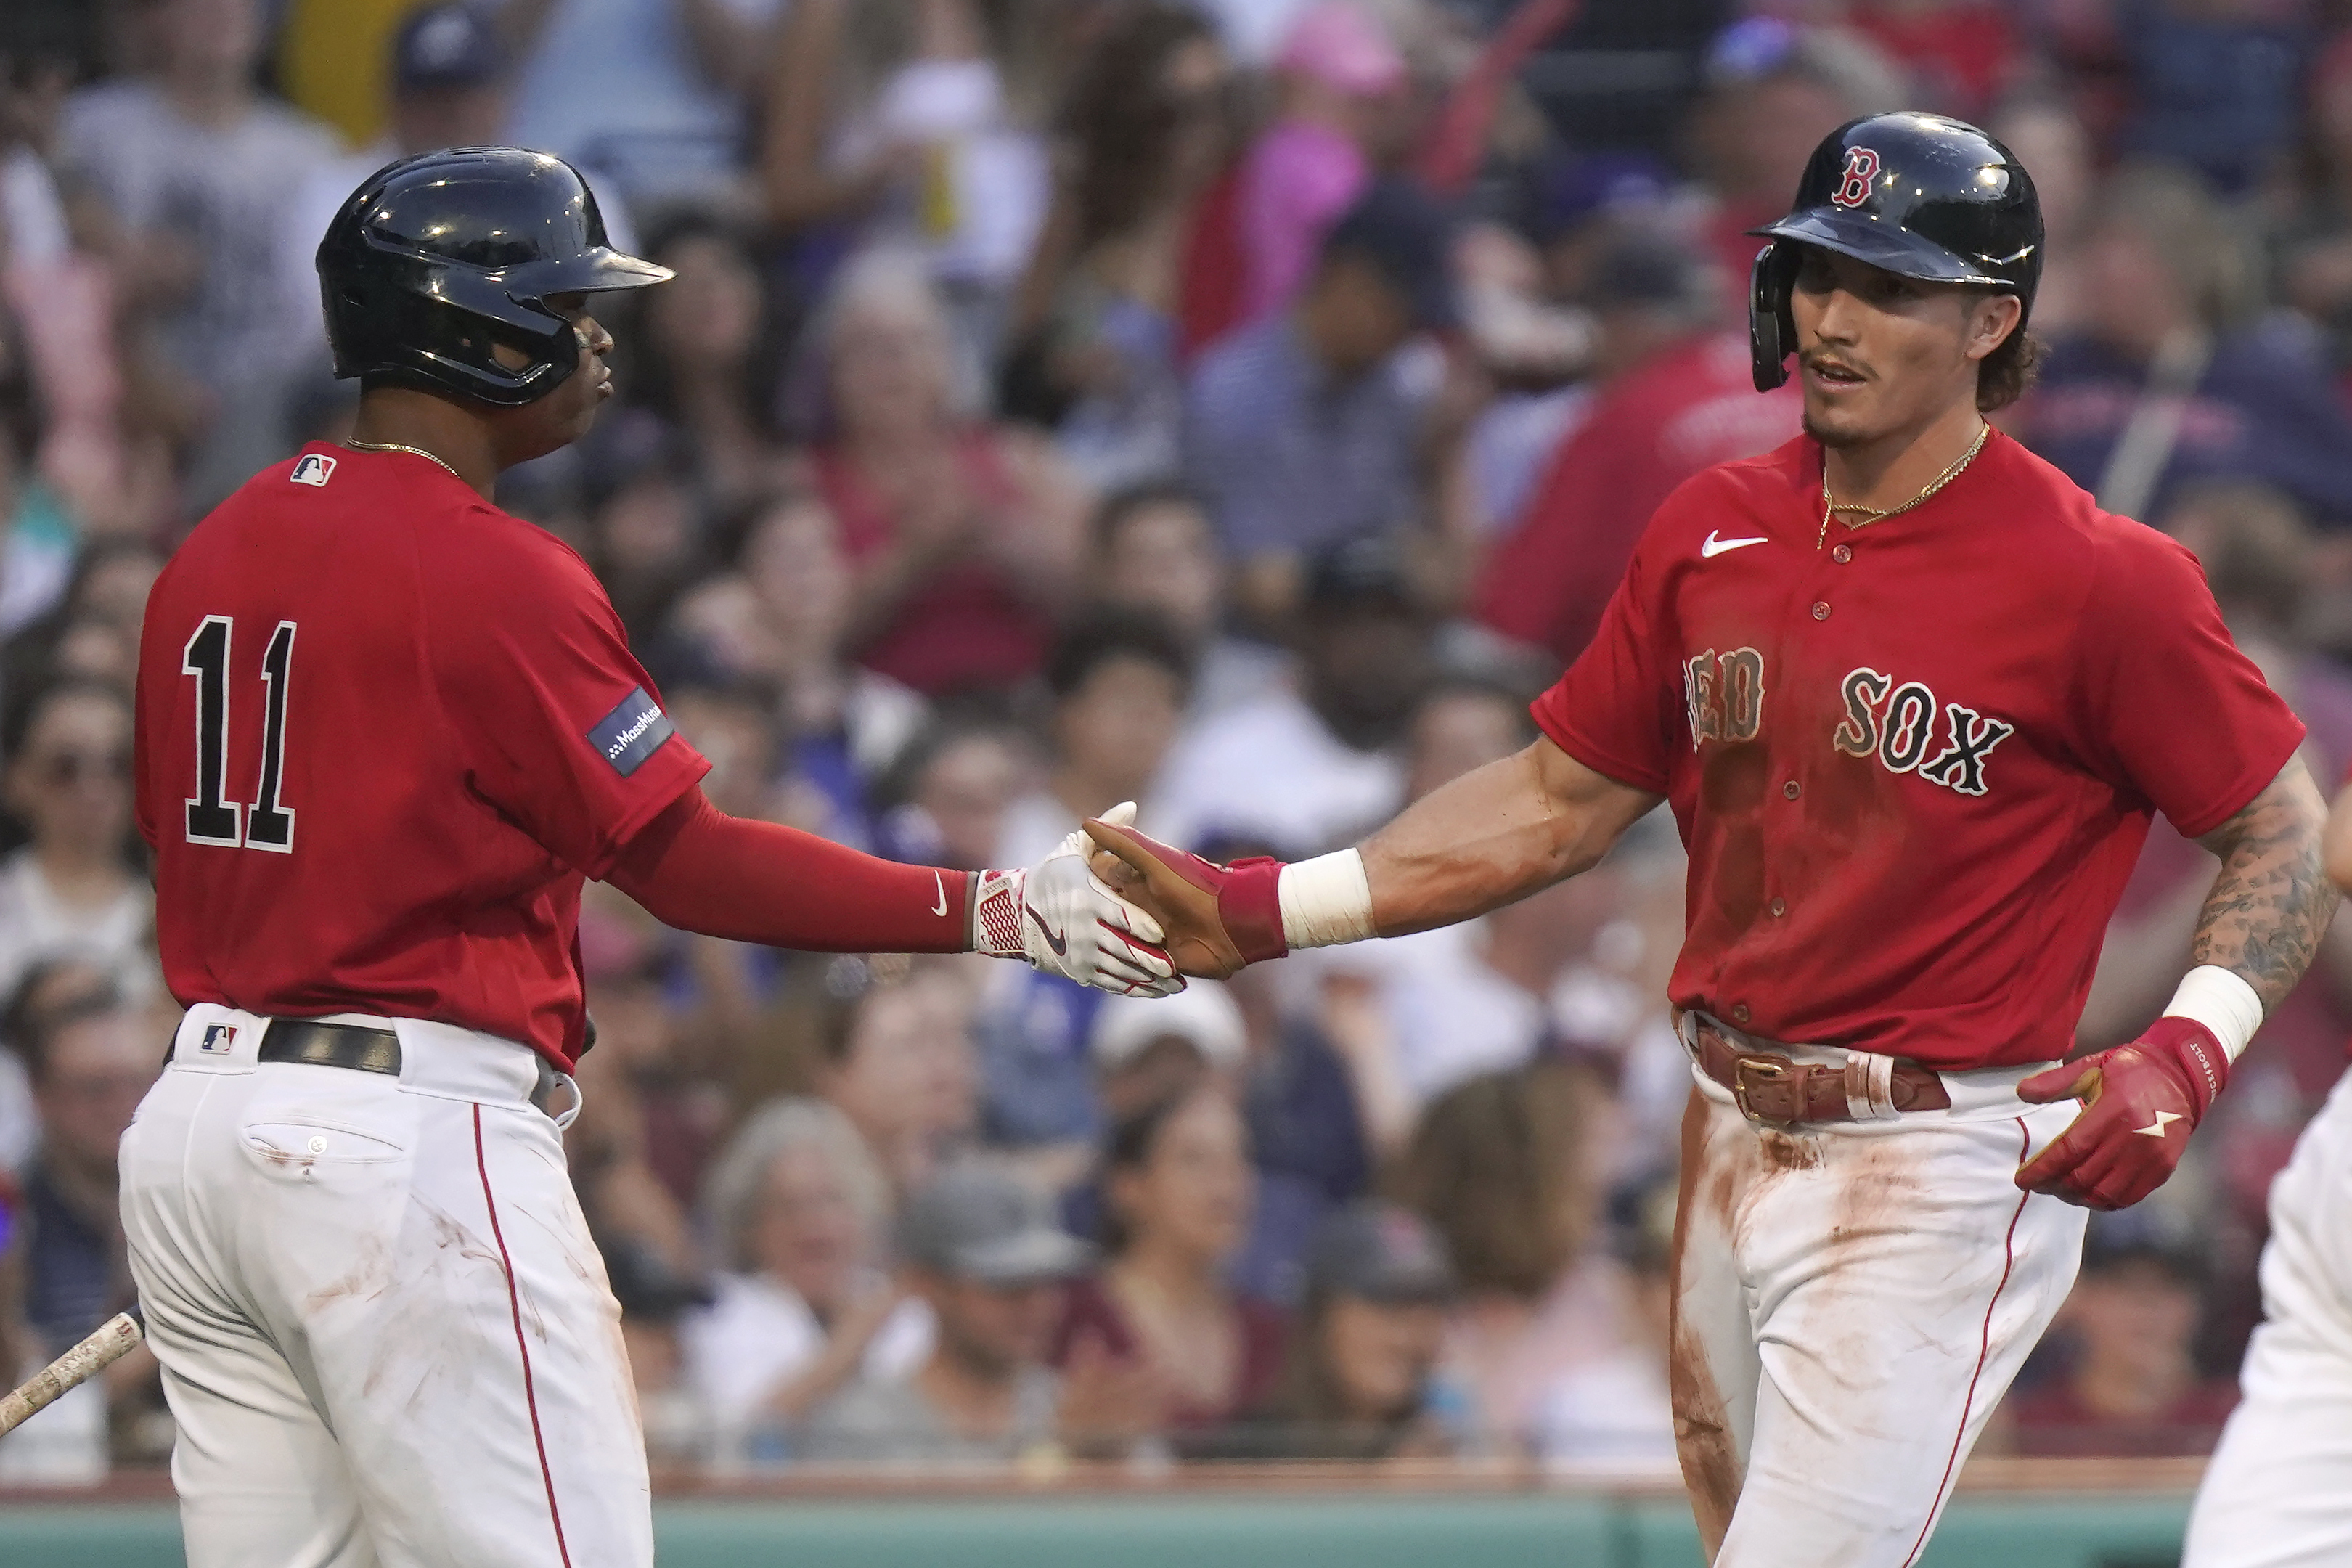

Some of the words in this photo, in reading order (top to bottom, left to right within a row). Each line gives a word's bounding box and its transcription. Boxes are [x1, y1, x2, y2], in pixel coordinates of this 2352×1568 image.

[1831, 145, 1882, 208] B
[182, 614, 298, 854] 11
[616, 703, 662, 748] MassMutu
[1833, 666, 2014, 796] SOX
[2189, 1042, 2210, 1069] BOLT
